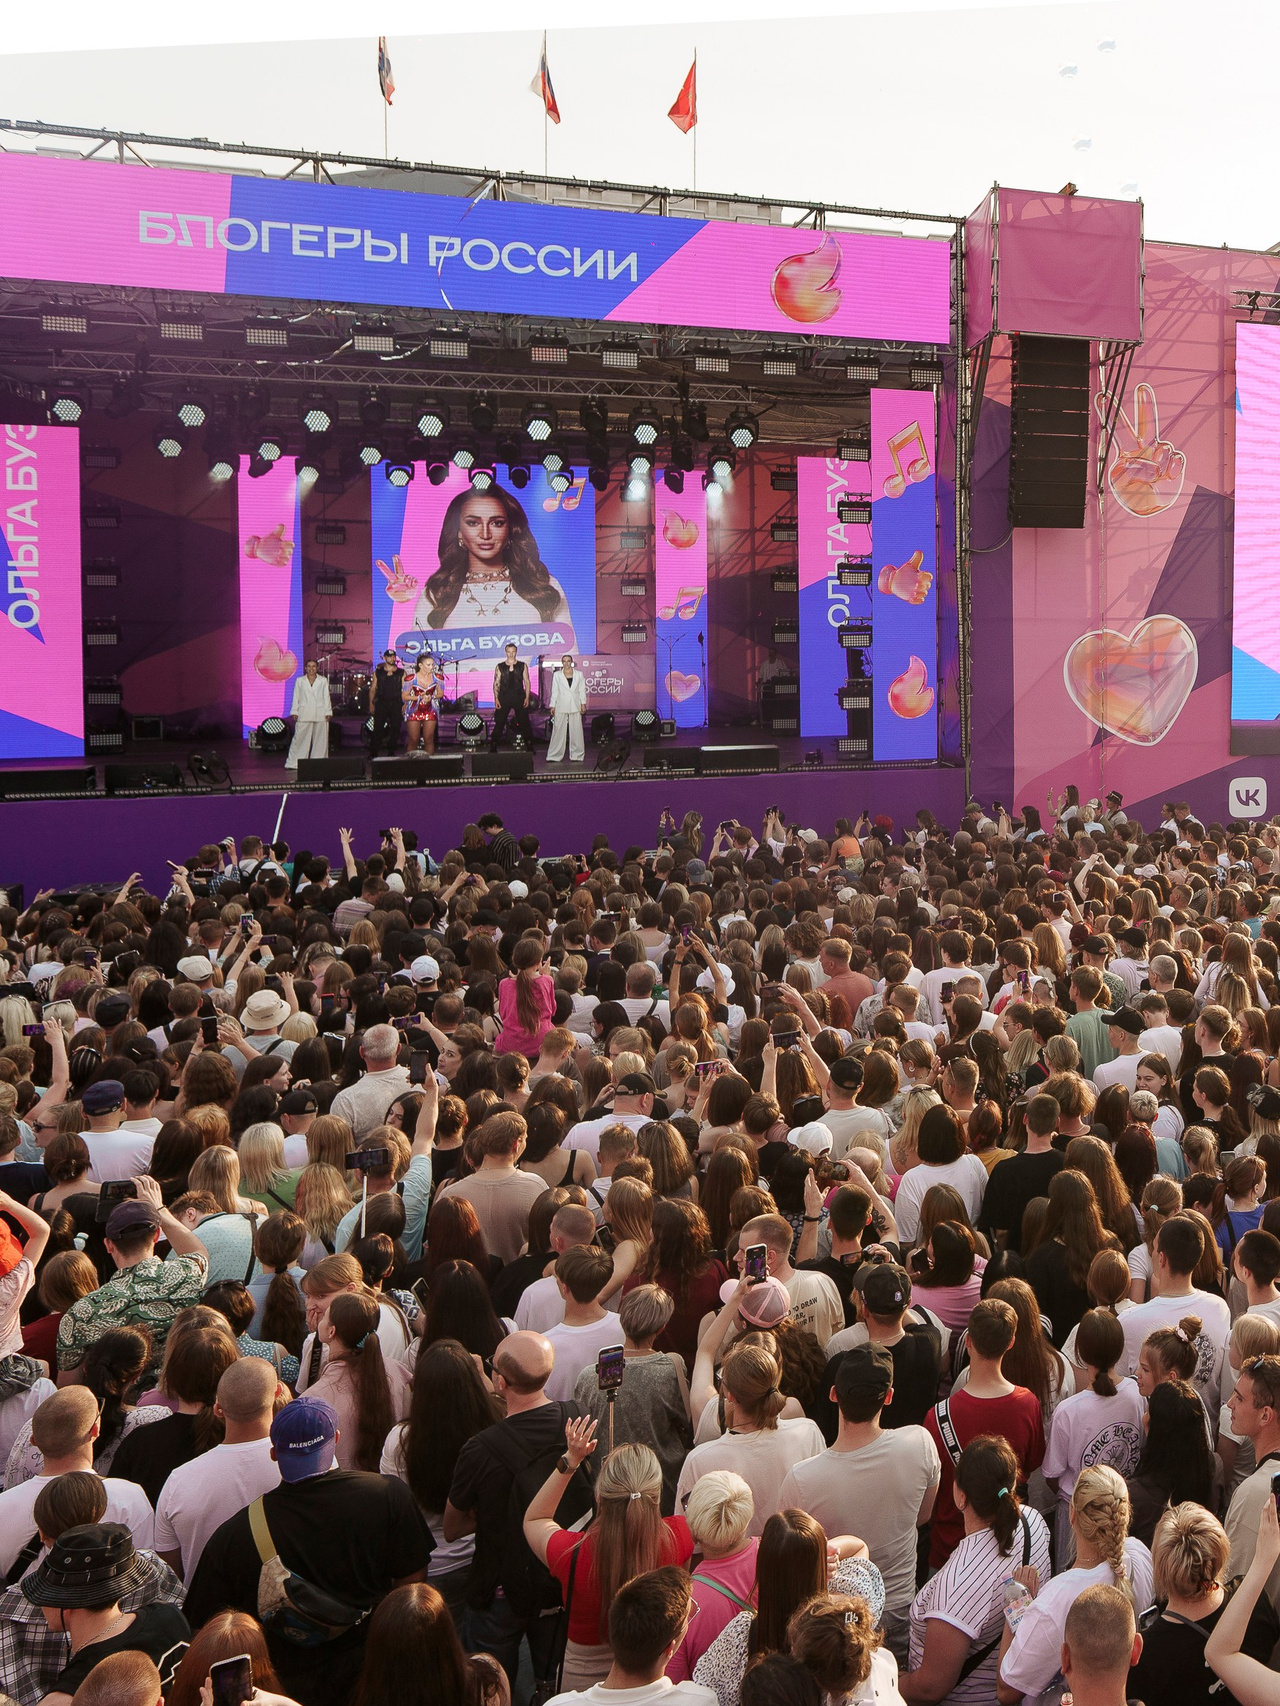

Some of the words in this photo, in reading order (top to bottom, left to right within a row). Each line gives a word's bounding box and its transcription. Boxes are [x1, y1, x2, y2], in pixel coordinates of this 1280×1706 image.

[139, 210, 407, 264] БЛОГЕРЫ
[429, 235, 638, 282] РОССИИ
[7, 498, 41, 629] ОЛЬГА
[405, 637, 476, 654] ОЛЬГА
[478, 632, 566, 649] БУЗОВА
[585, 677, 624, 686] ОГЕРЫ
[1235, 789, 1260, 807] VK
[800, 1296, 819, 1310] DRAW
[289, 1435, 325, 1449] BALENCIAGA
[941, 1421, 956, 1448] PUMA
